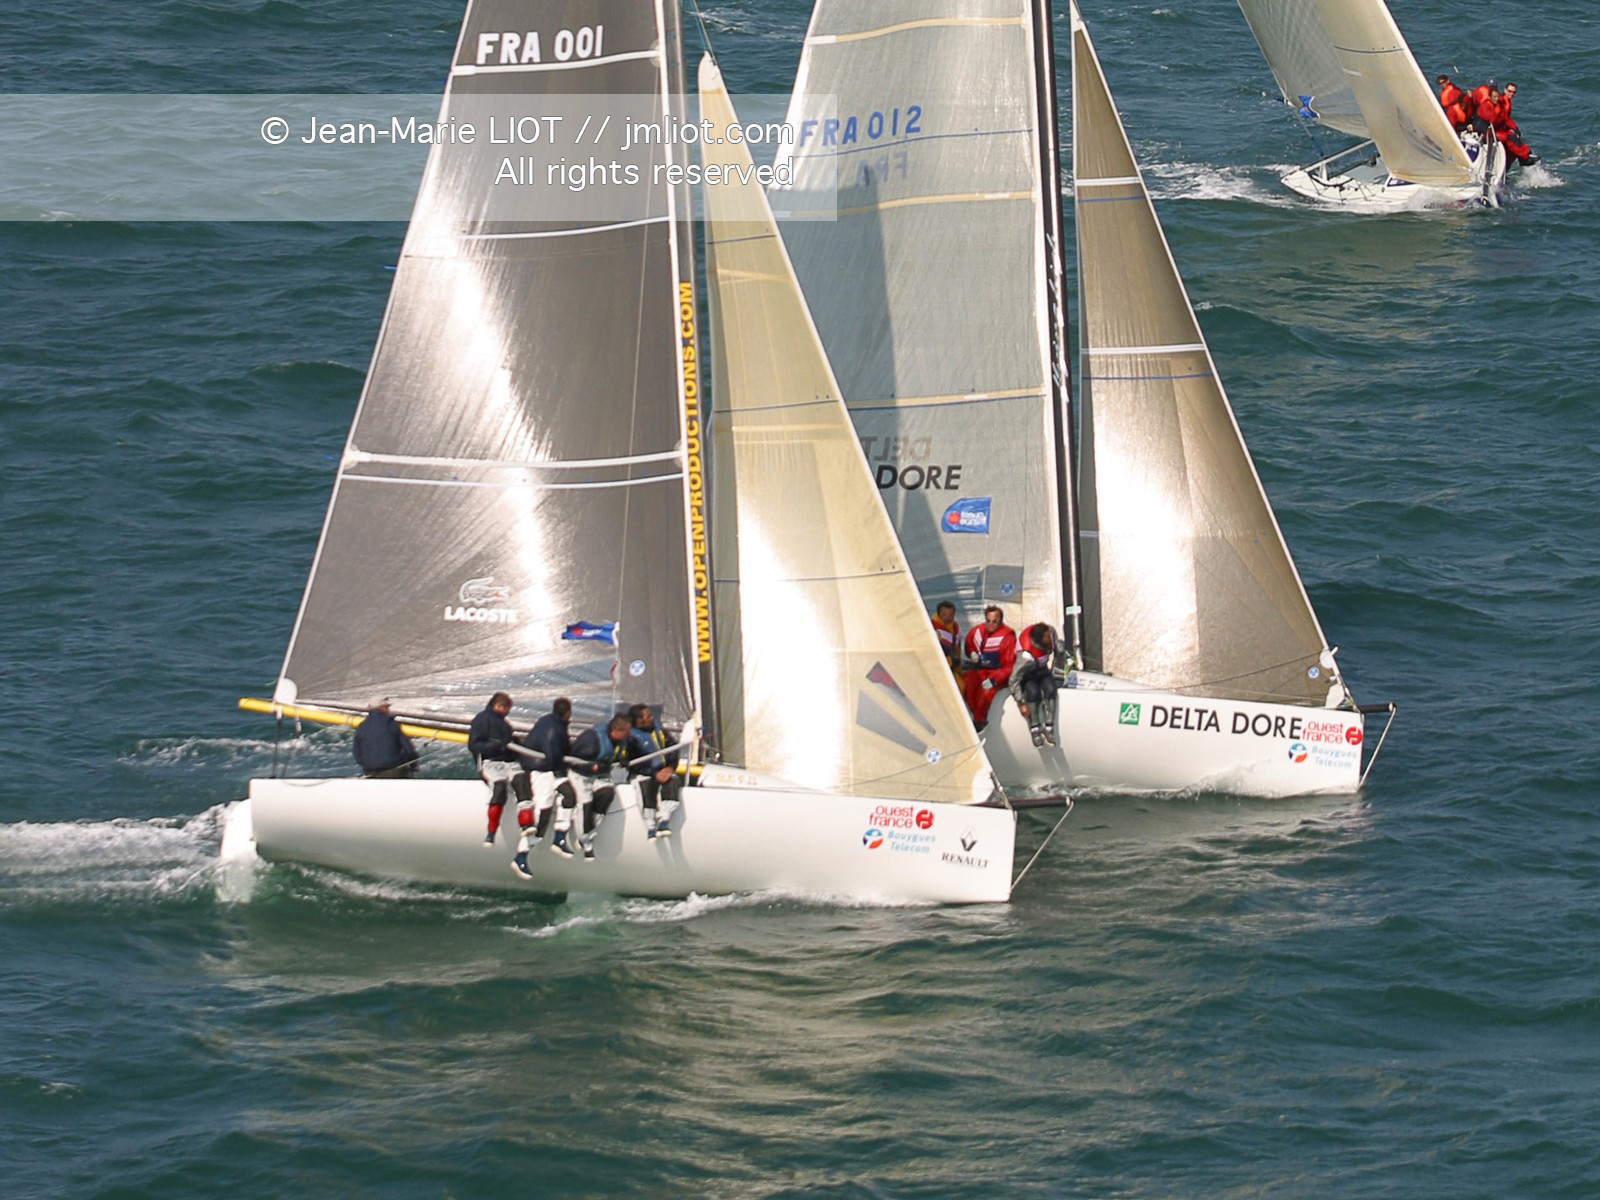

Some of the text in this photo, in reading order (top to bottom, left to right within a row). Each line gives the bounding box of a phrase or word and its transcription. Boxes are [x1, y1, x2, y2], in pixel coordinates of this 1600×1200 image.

[476, 25, 603, 64] FRA 001
[679, 281, 711, 663] WWW.OPENPRODUCTIONS.COM
[876, 464, 962, 490] DORE
[444, 606, 518, 623] LACOSTE
[1150, 704, 1302, 740] DELTA DORE
[1308, 720, 1343, 734] ouest
[1302, 728, 1343, 744] france
[875, 804, 914, 817] ouest
[868, 812, 914, 829] france
[887, 829, 936, 843] Bouygues
[890, 841, 930, 854] Telecom
[942, 851, 989, 869] RENAULT
